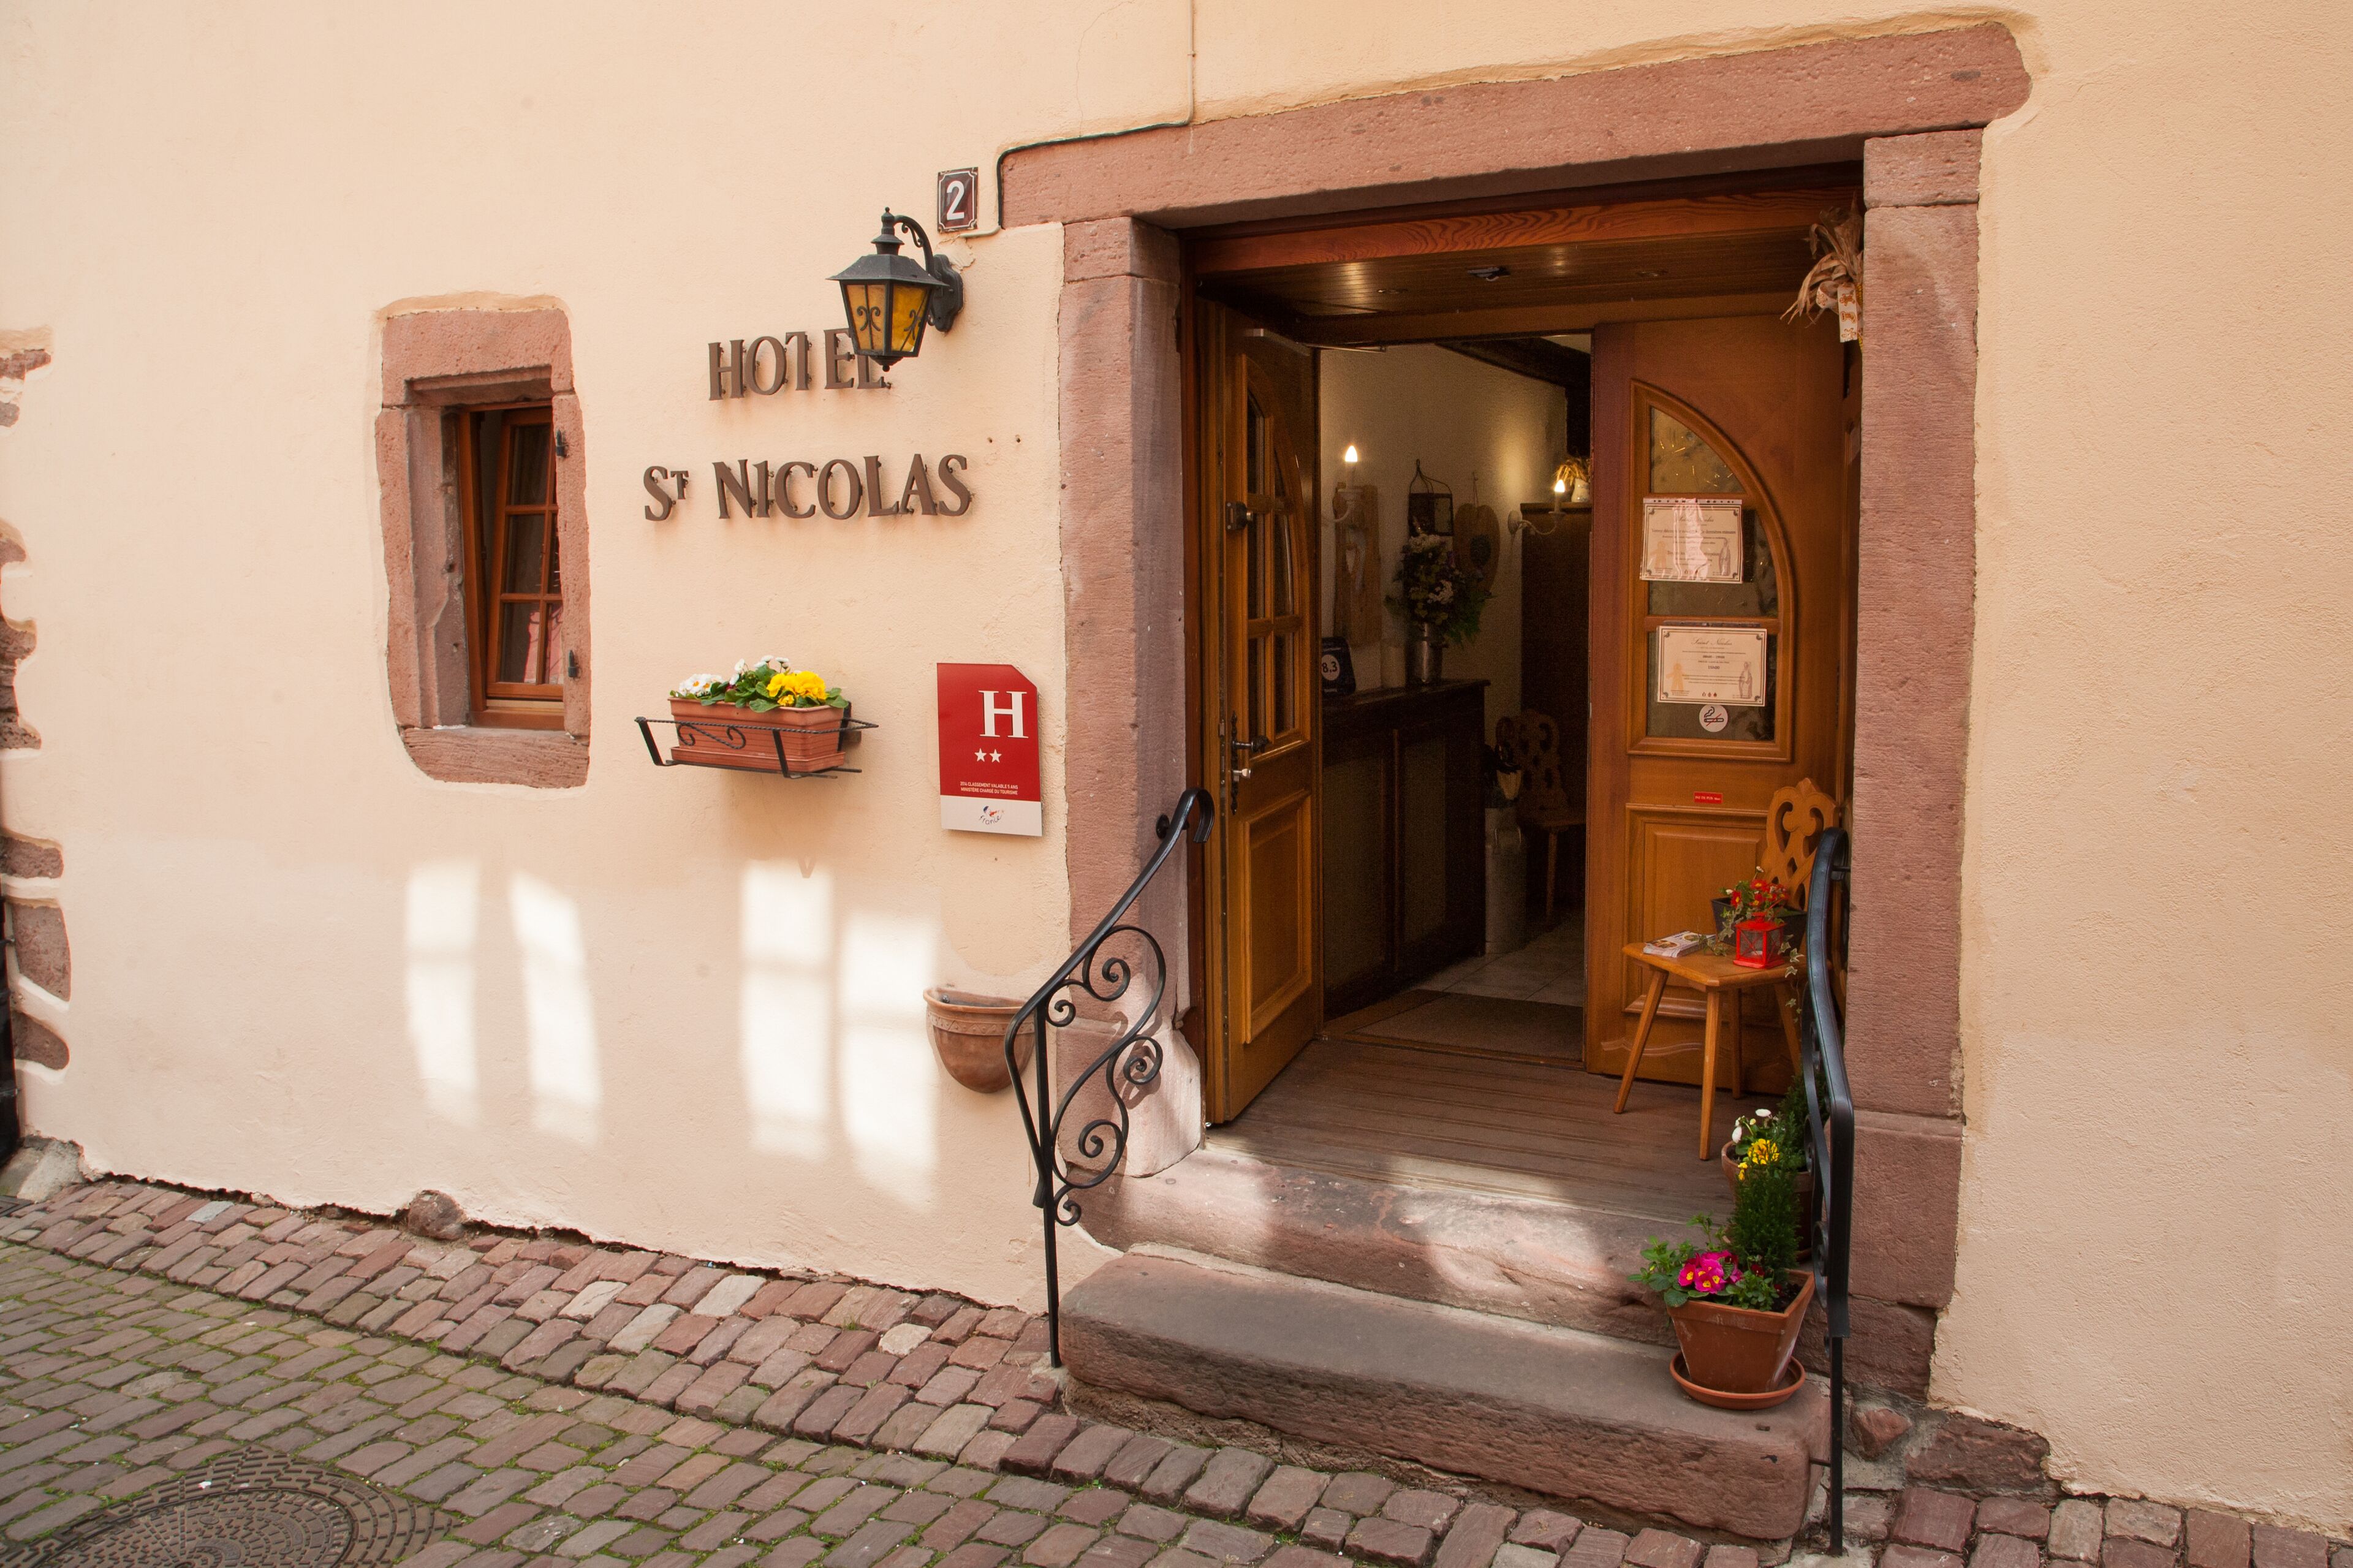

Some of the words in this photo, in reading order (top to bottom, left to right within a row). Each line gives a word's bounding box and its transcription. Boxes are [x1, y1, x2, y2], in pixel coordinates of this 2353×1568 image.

[945, 180, 966, 221] 2
[712, 453, 974, 520] NICOLAS
[978, 690, 1029, 738] H
